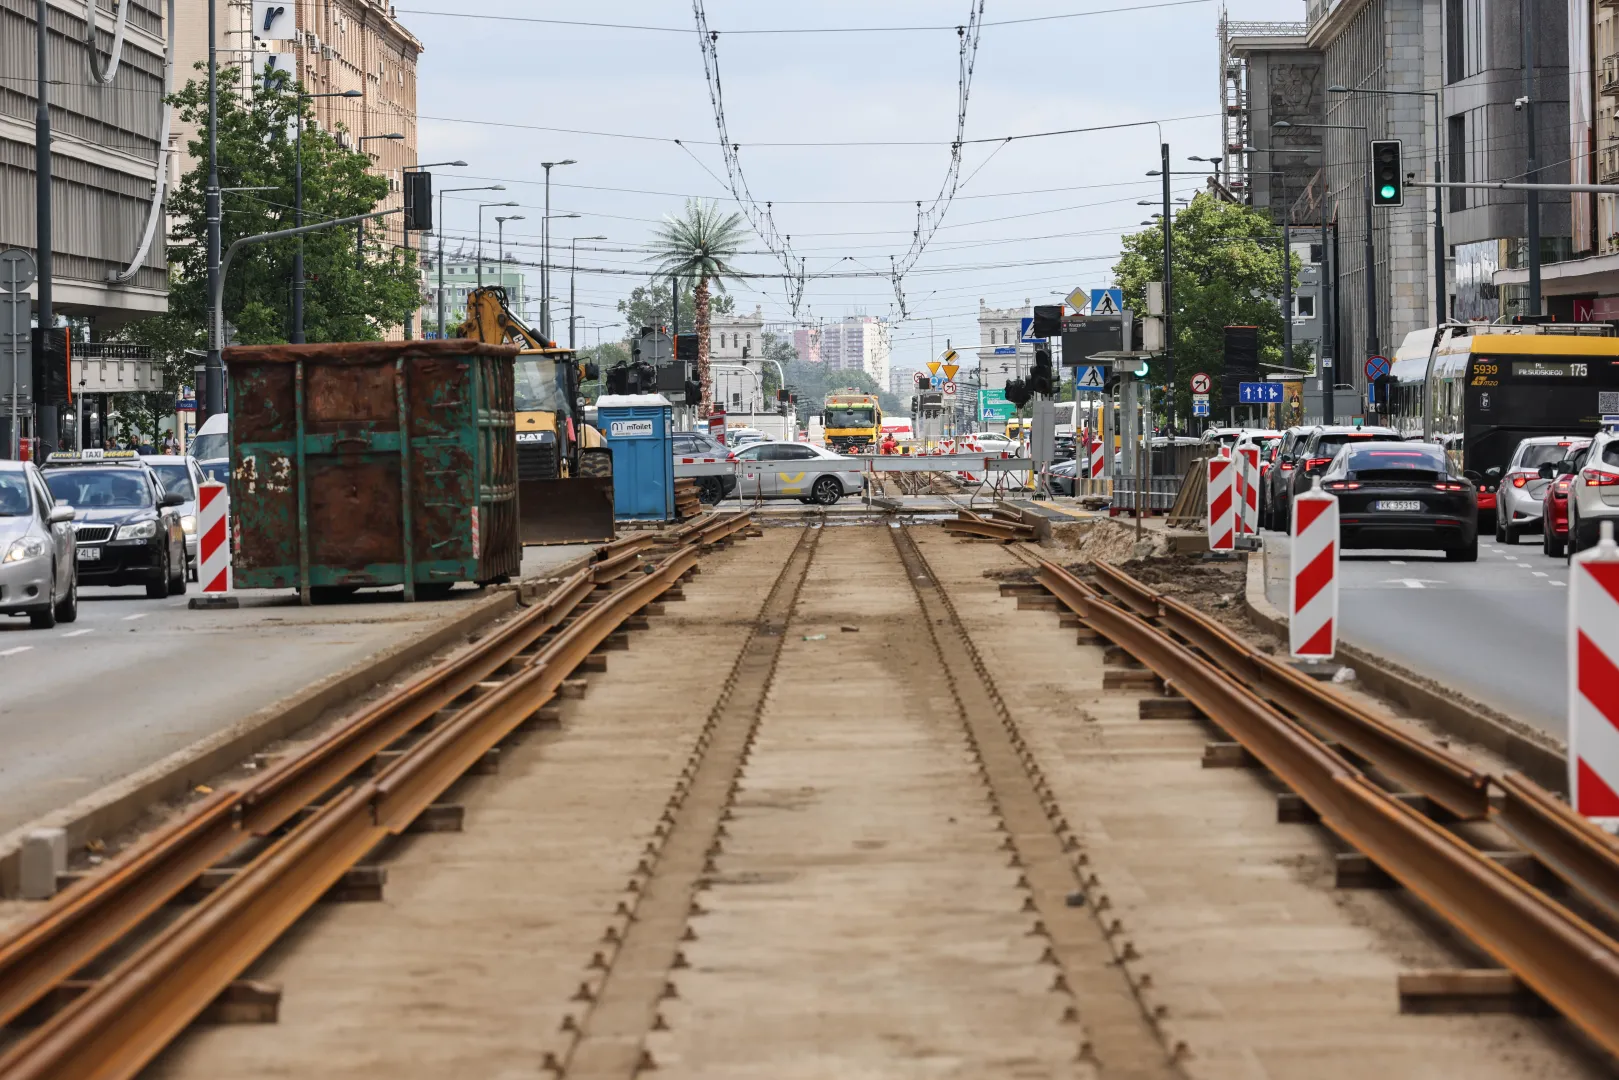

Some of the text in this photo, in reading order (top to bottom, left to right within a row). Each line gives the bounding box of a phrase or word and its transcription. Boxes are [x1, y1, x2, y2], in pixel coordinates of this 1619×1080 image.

[1473, 364, 1498, 375] 5939
[1569, 363, 1588, 377] 175
[516, 433, 544, 442] CAT
